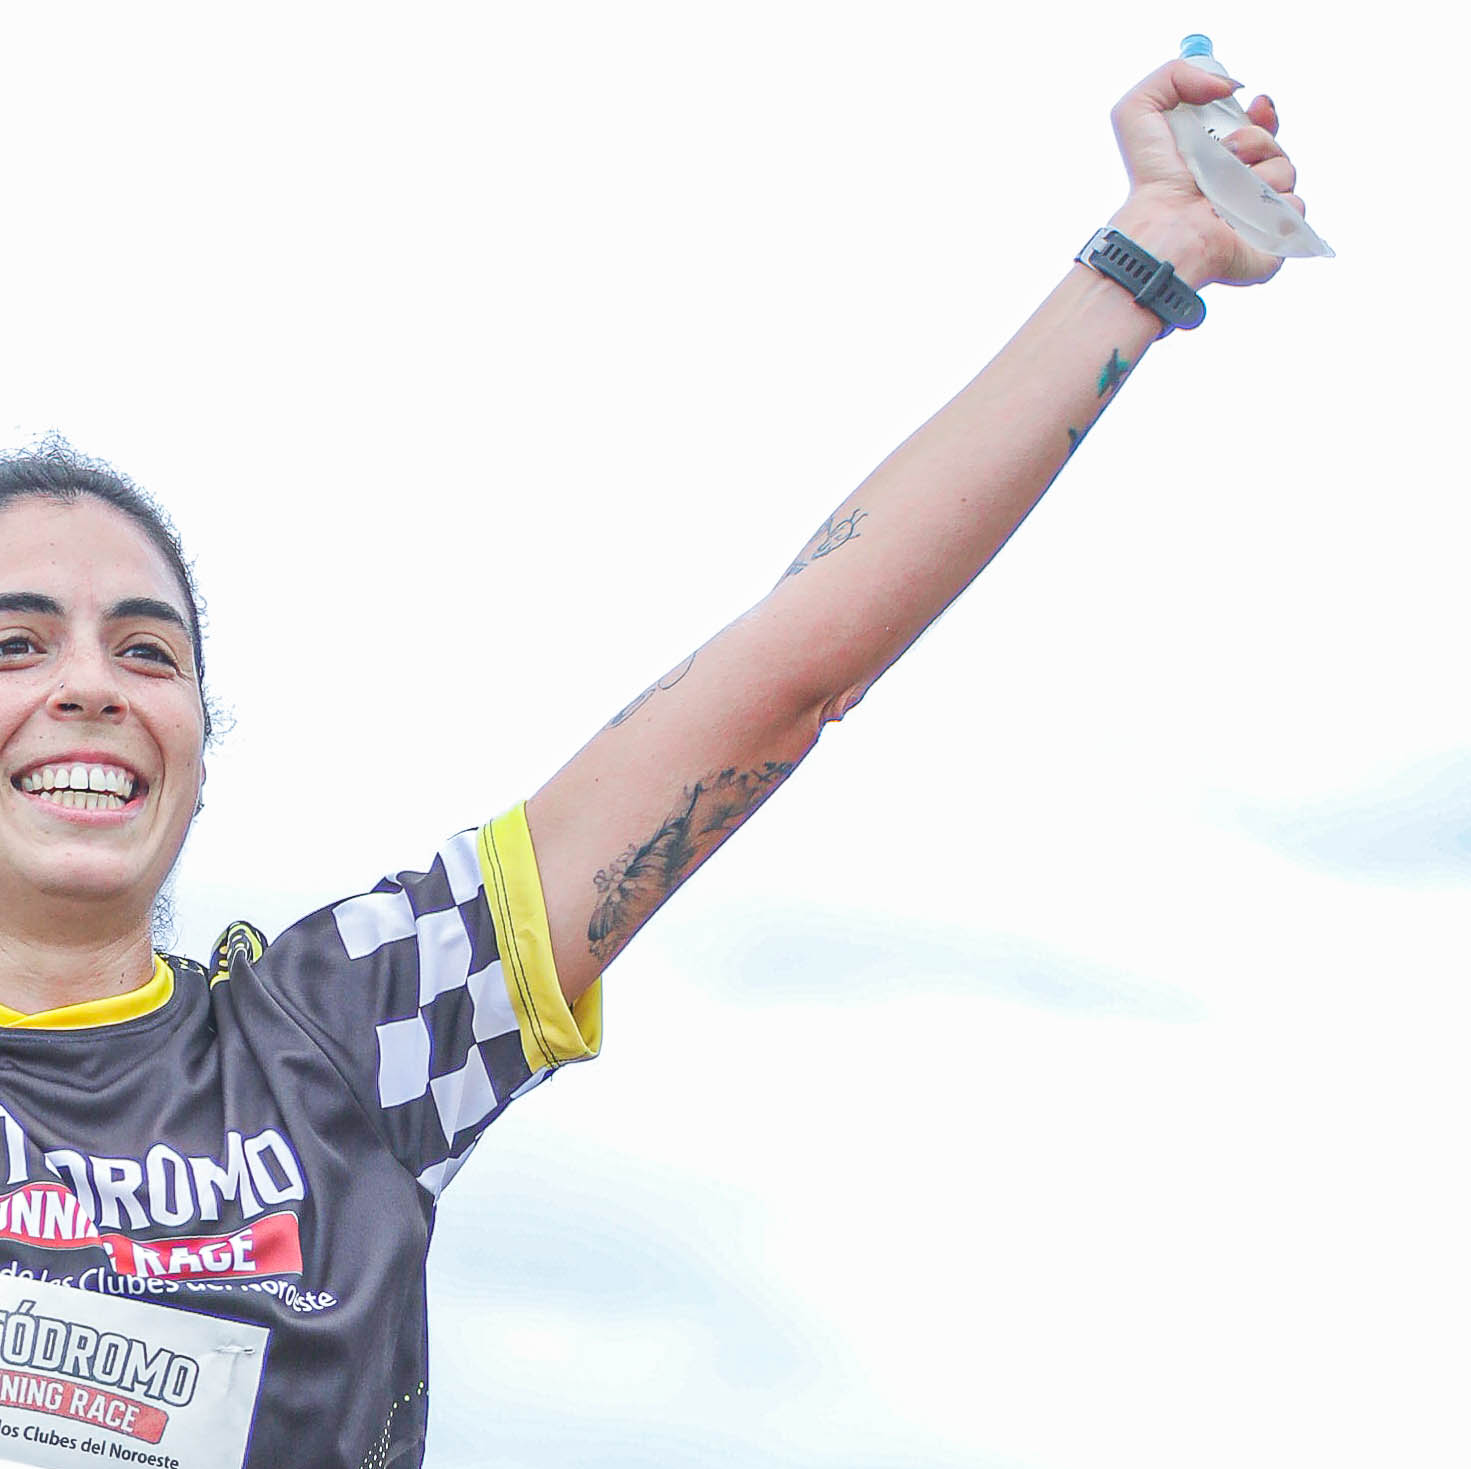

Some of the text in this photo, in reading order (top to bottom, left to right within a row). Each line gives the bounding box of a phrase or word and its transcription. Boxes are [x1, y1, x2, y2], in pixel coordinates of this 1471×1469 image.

[79, 1267, 179, 1295] Clubes
[70, 1388, 140, 1433] RACE
[23, 1425, 77, 1450] Clubes
[80, 1437, 106, 1456] del
